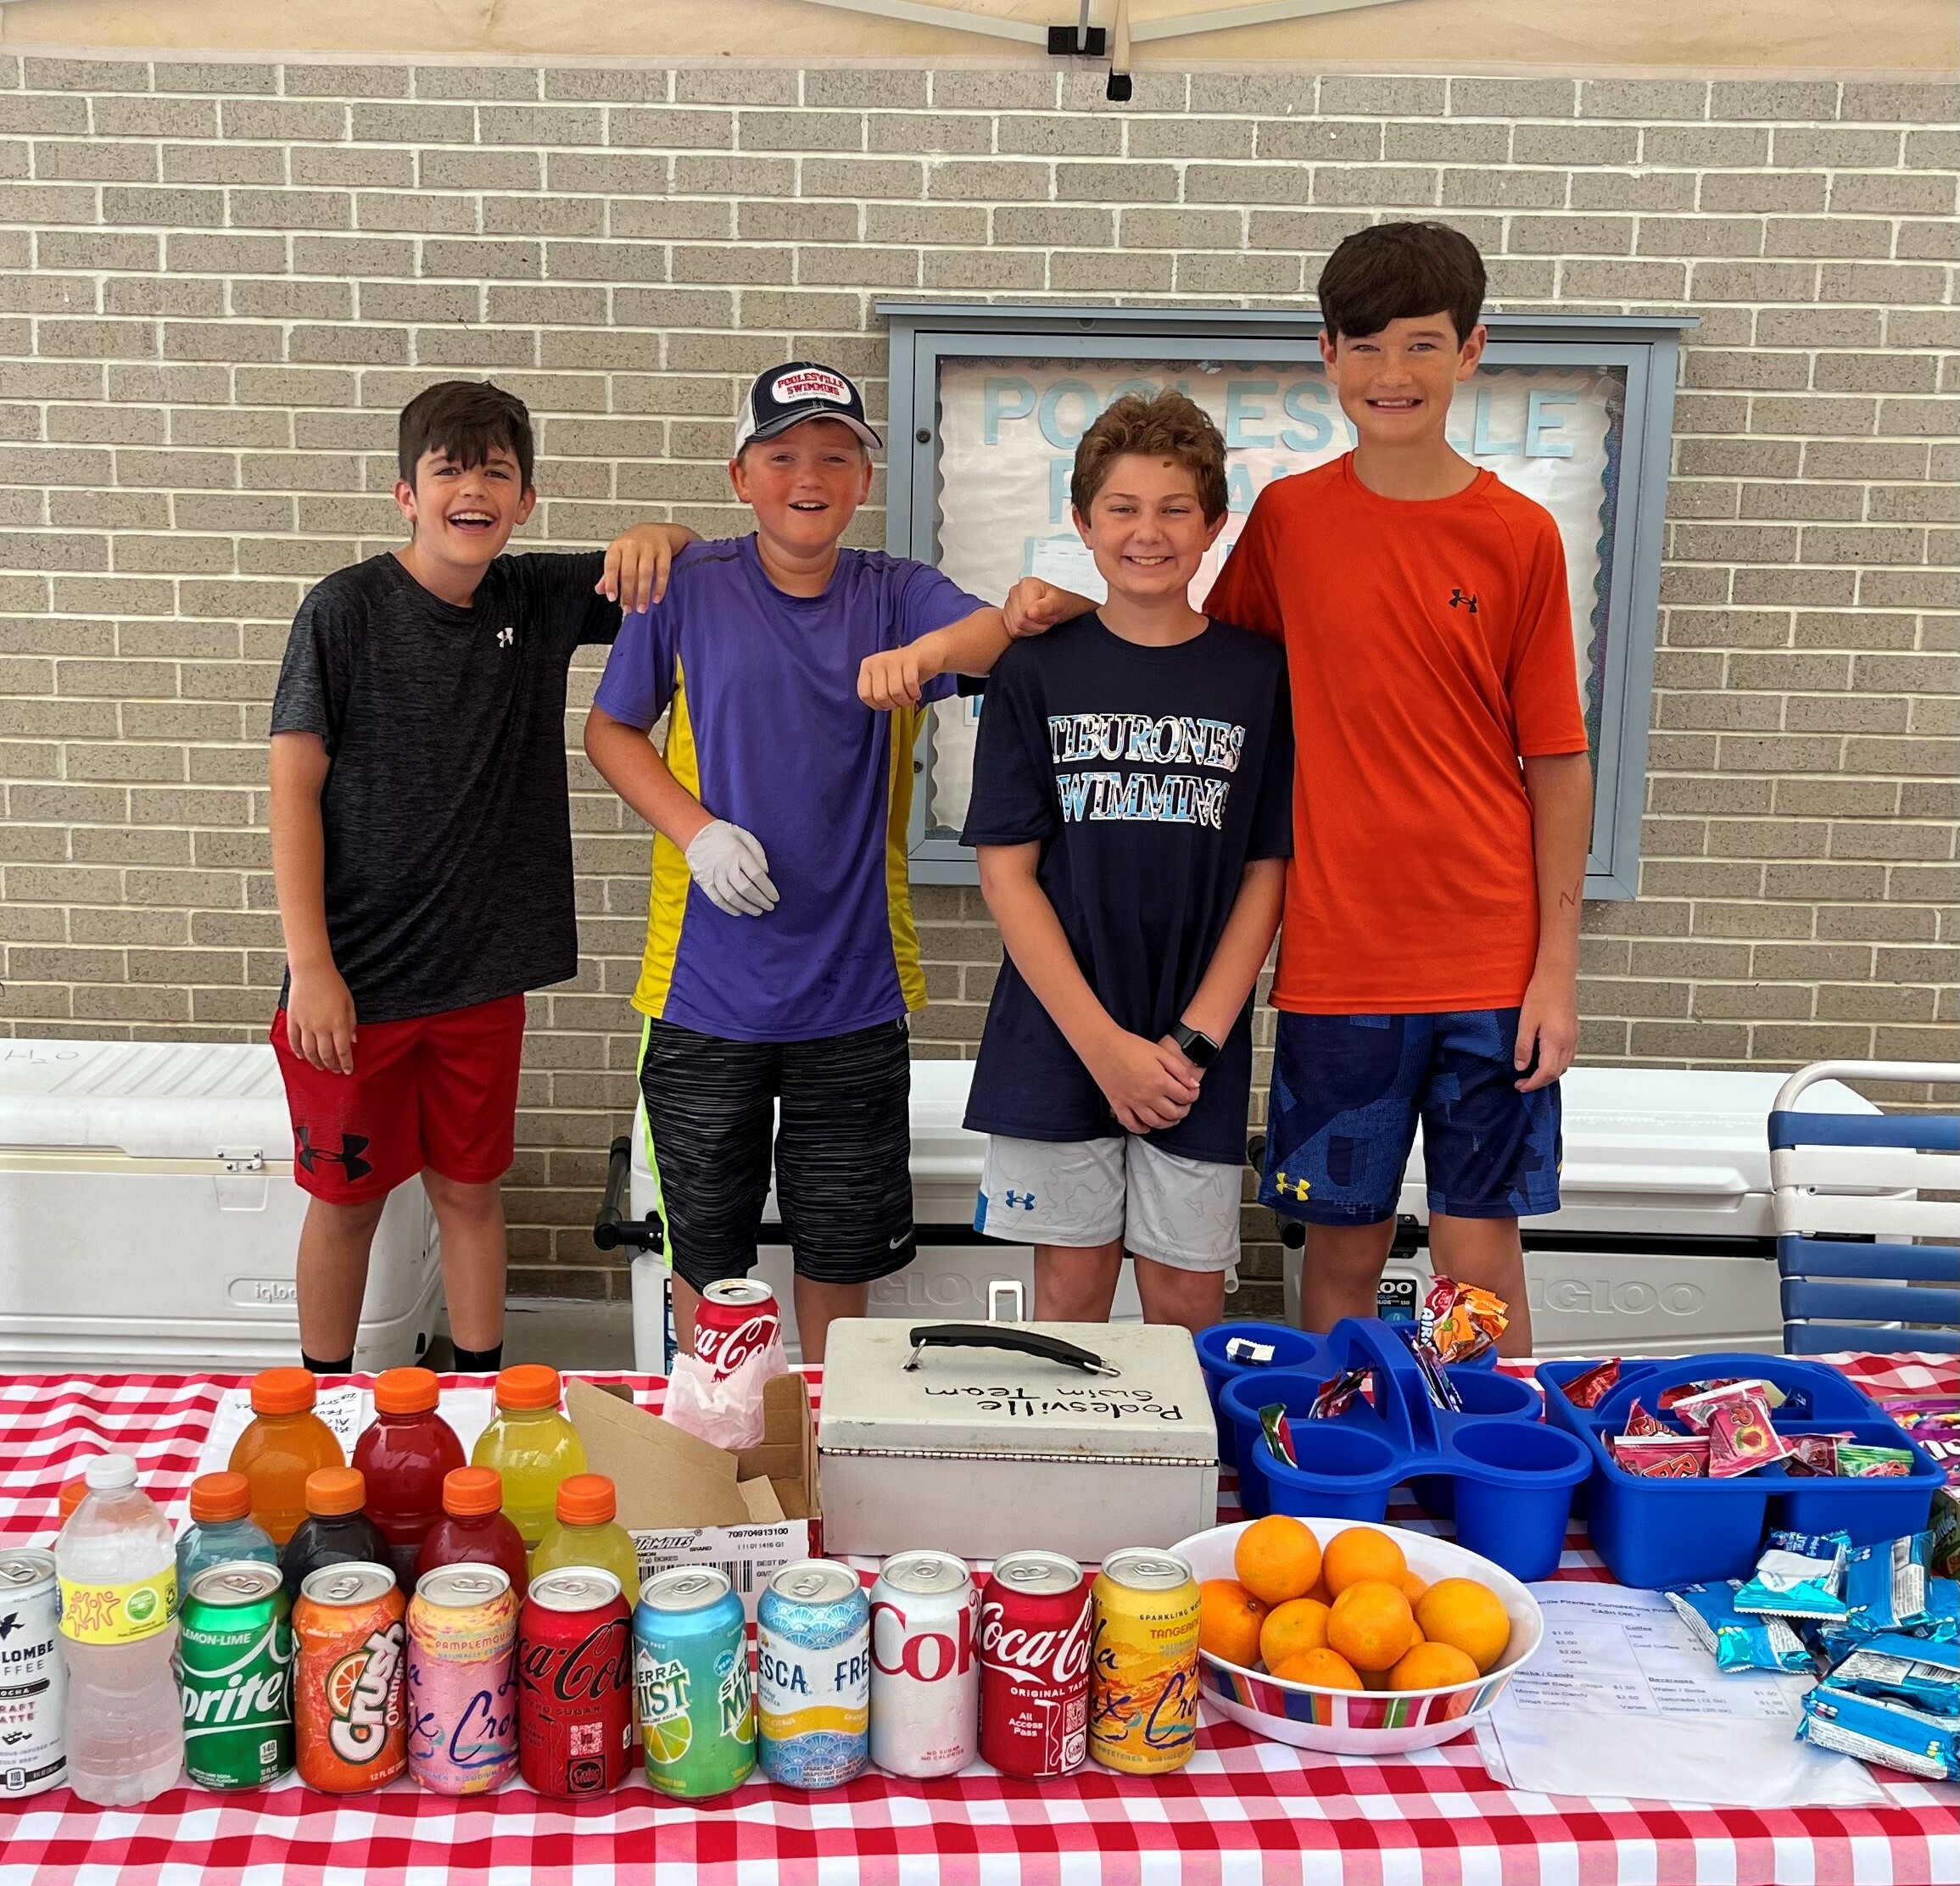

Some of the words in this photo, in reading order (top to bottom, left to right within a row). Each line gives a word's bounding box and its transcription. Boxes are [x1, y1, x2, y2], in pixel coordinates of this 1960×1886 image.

[984, 377, 1578, 458] POESLE
[1047, 713, 1246, 773] TIBURONES
[1056, 772, 1230, 829] WIMMING
[1526, 1277, 1706, 1316] IGLOO
[924, 1387, 1041, 1399] Team
[1057, 1387, 1153, 1402] Swim
[977, 1400, 1183, 1420] Poolesville
[1139, 1608, 1188, 1621] SPARKLING
[182, 1626, 252, 1646] LEMON-LIME
[869, 1601, 980, 1682] Cok
[2, 1638, 55, 1664] LOMBE
[4, 1659, 45, 1677] FFEE
[639, 1662, 681, 1683] ERRA
[758, 1648, 808, 1696] ESCA
[835, 1648, 869, 1692] FRE
[0, 1688, 30, 1697] OCHA
[182, 1671, 284, 1724] prite
[329, 1621, 405, 1764] Crush
[1010, 1687, 1065, 1698] ORIGINAL
[0, 1701, 36, 1713] RAFT
[1019, 1712, 1033, 1721] All
[0, 1713, 35, 1724] ATTE
[1008, 1718, 1043, 1729] Access
[1014, 1727, 1038, 1737] Pass
